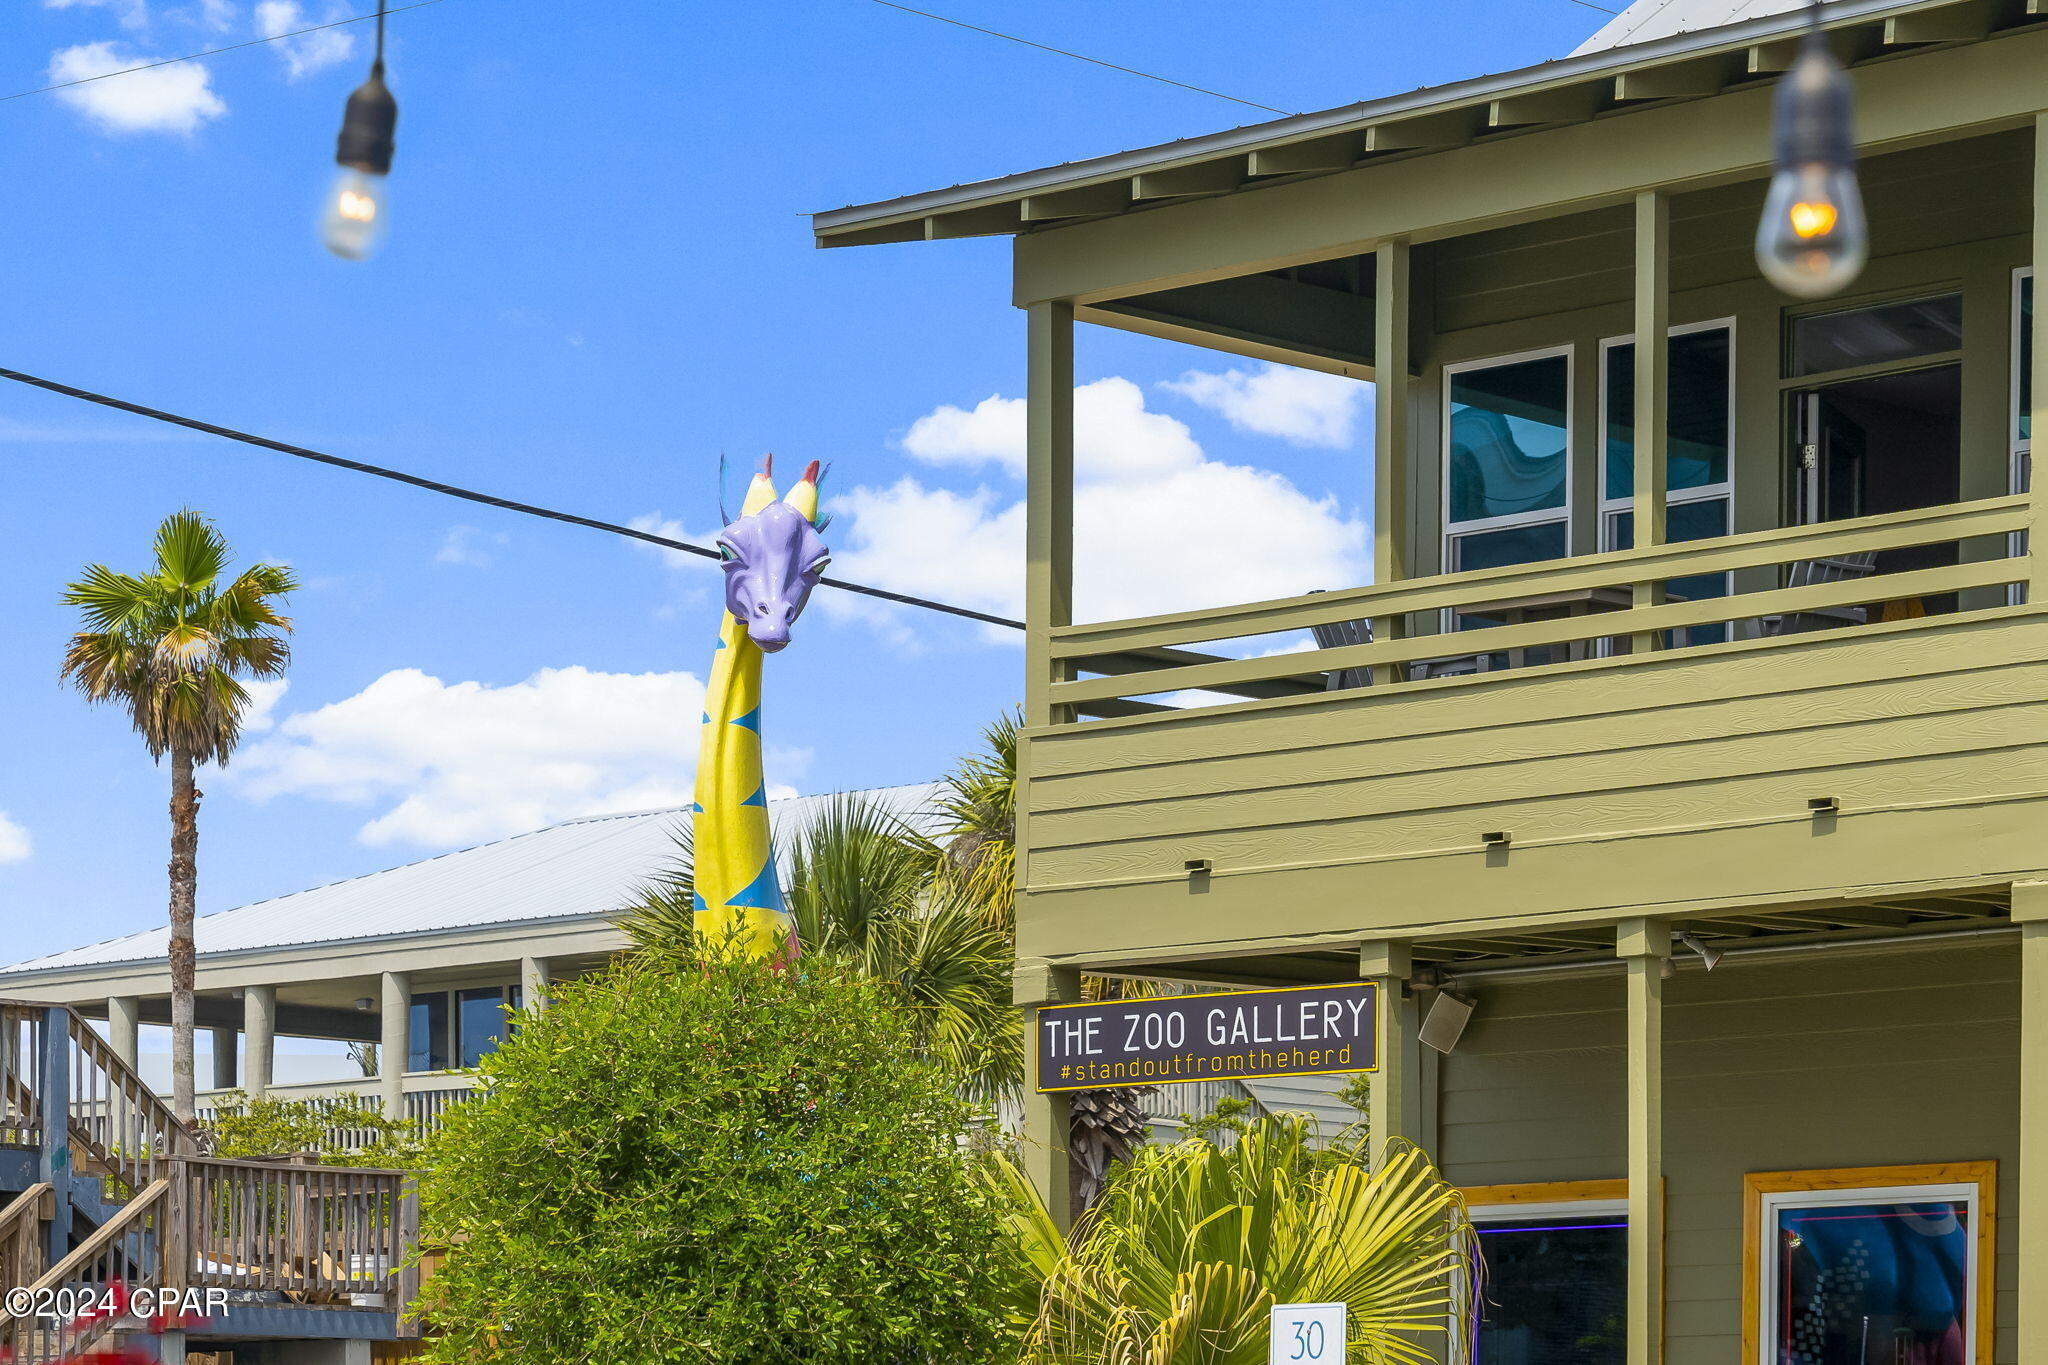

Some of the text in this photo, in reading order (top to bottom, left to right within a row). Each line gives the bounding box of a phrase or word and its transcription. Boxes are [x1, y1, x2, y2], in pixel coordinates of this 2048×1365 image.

[1045, 998, 1367, 1058] THE ZOO GALLERY
[1060, 1044, 1351, 1081] #standoutfromtheherd
[1291, 1320, 1325, 1360] 30
